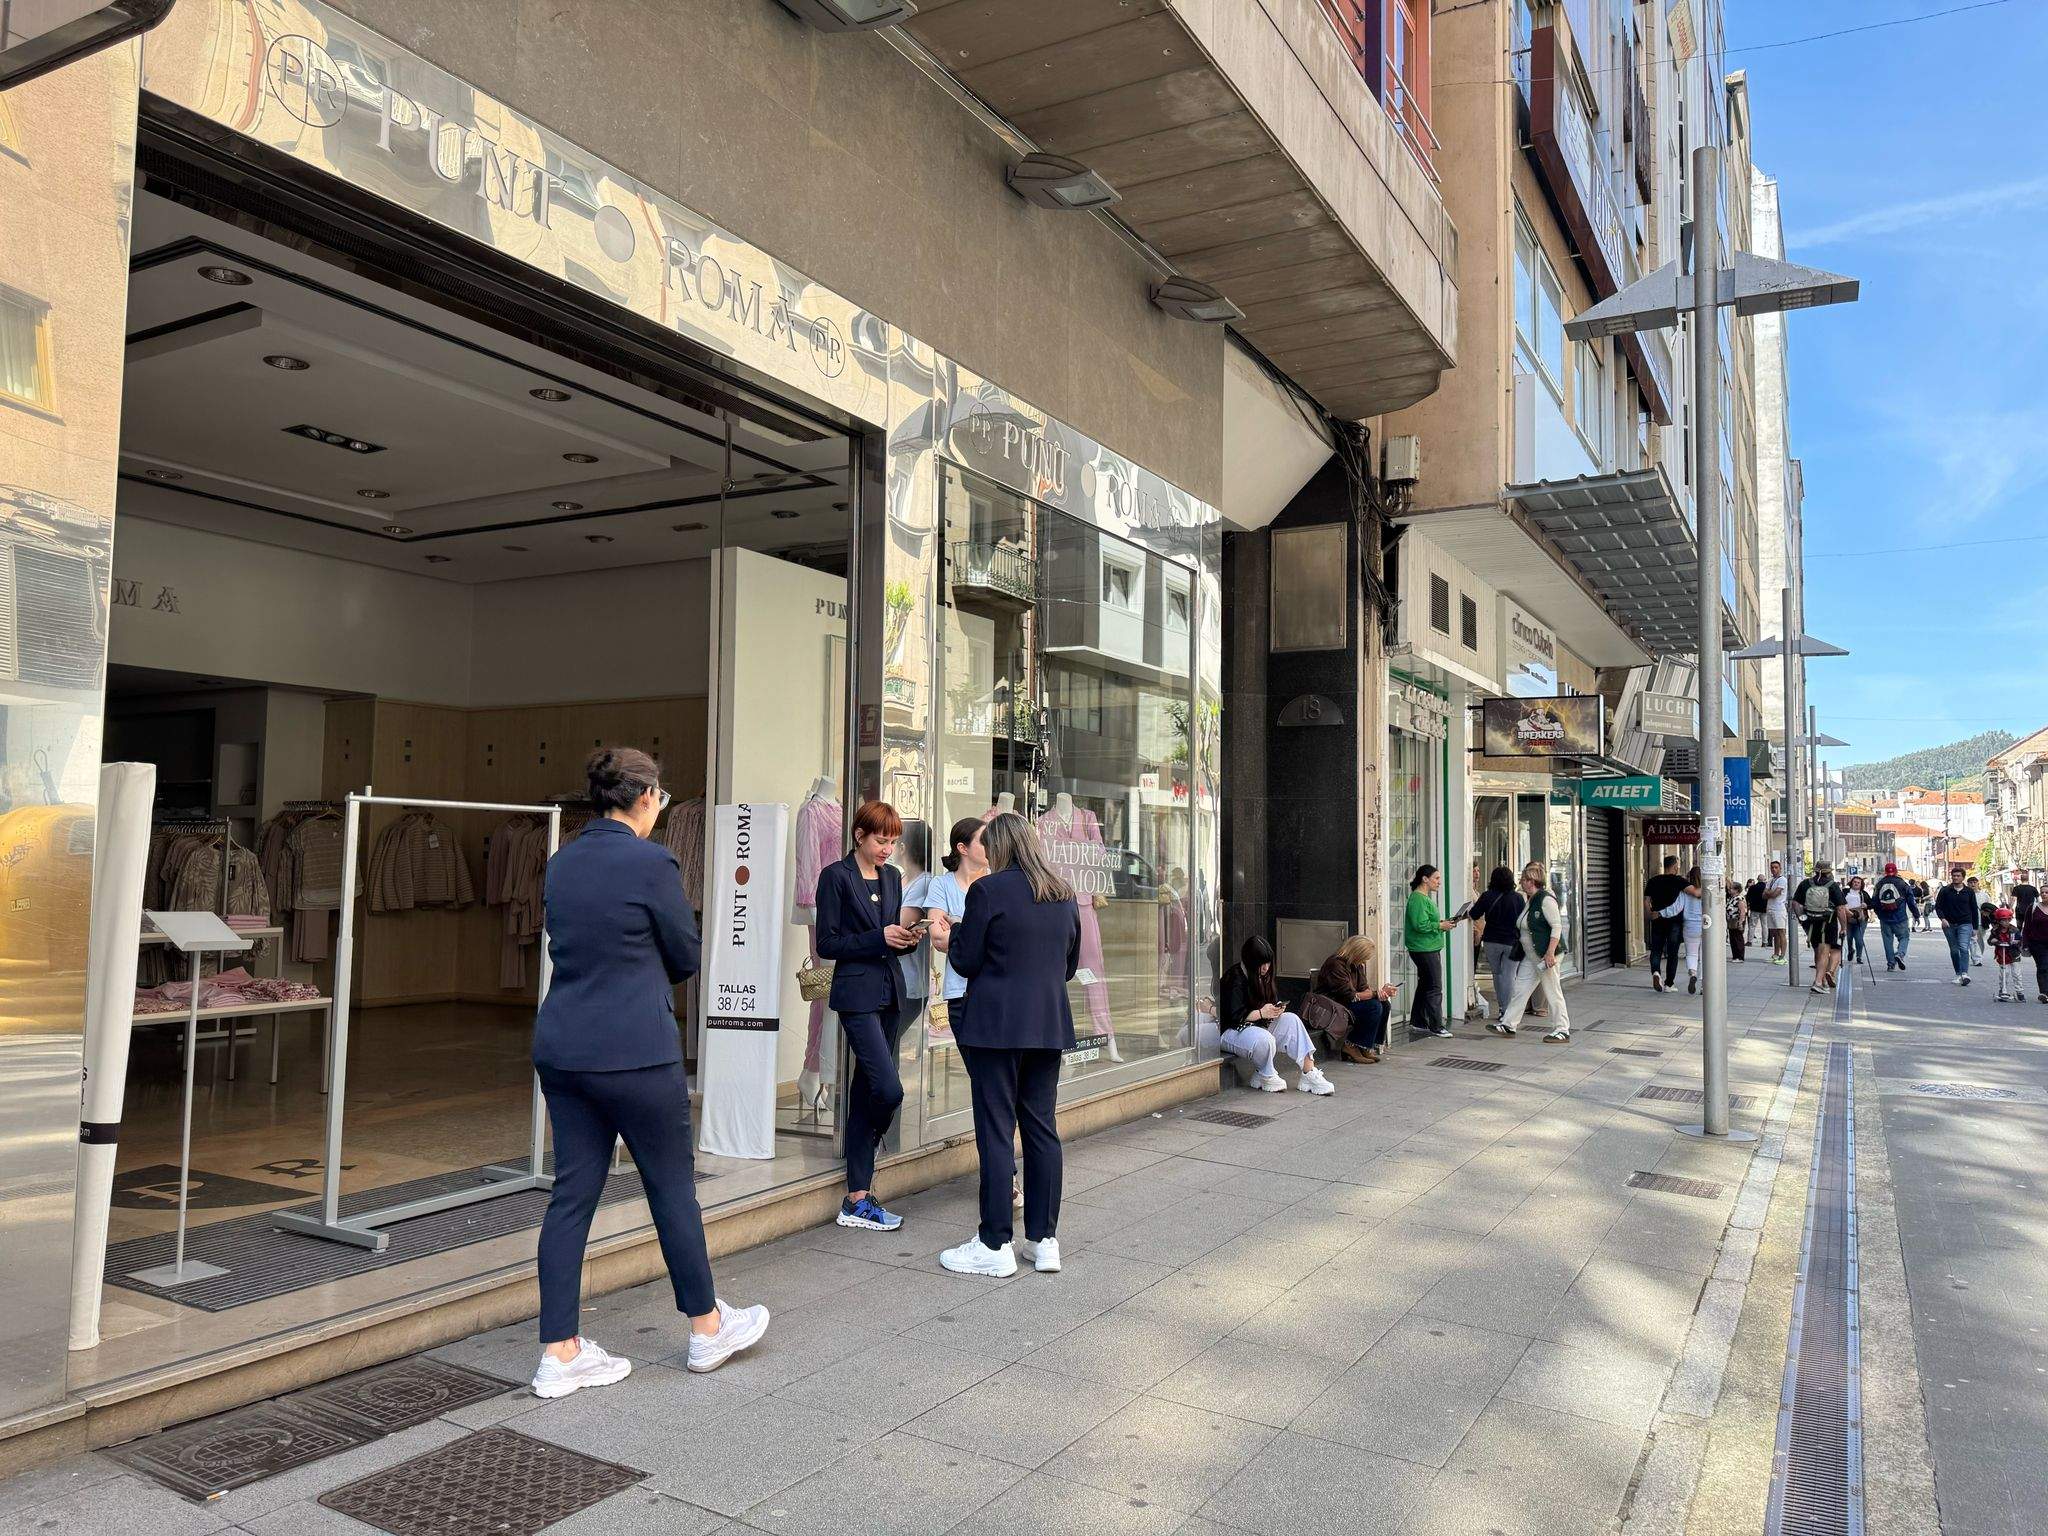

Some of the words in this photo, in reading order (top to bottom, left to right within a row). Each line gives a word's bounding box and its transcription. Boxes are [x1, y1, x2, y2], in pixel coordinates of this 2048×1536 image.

[376, 82, 567, 231] PUNT
[662, 236, 797, 352] ROMA
[1645, 697, 1691, 715] LUCHI
[1517, 730, 1564, 740] SNEAKERS
[1591, 785, 1653, 798] ATLEET
[736, 803, 752, 860] ROMA
[1648, 824, 1657, 836] A
[1044, 838, 1101, 867] MADRE
[1101, 841, 1123, 871] está
[1070, 868, 1117, 895] MODA
[732, 889, 748, 948] PUNT
[718, 984, 756, 994] TALLAS
[708, 1019, 764, 1027] puntroma.com
